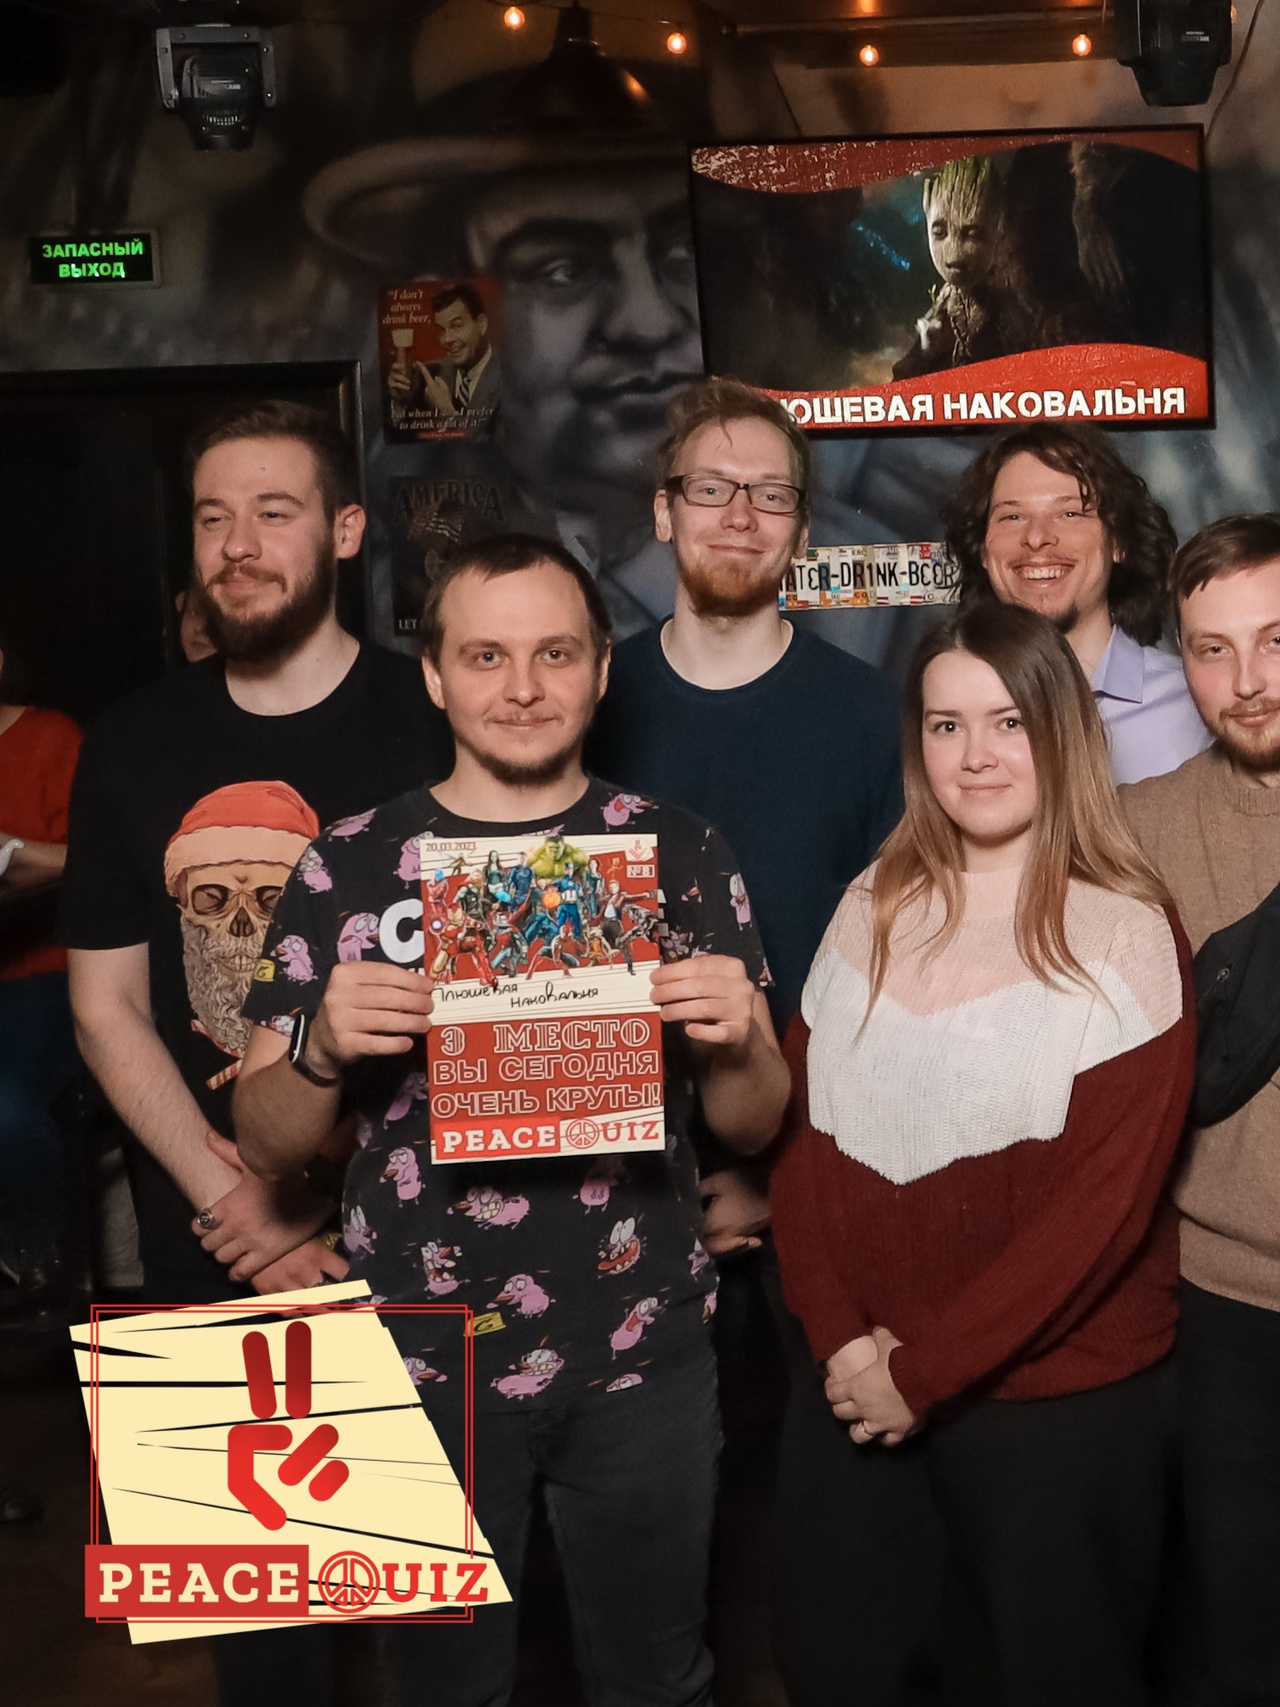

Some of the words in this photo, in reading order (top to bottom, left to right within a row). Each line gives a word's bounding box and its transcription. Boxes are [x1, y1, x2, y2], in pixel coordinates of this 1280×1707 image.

[42, 238, 144, 258] ЗАПАСНЫЙ
[58, 262, 125, 278] ВЫХОД
[400, 289, 423, 299] don't
[391, 302, 421, 312] always
[383, 314, 406, 324] drink
[408, 408, 432, 418] when
[466, 406, 495, 419] prefer
[779, 393, 934, 425] ЮШЕВАЯ
[942, 387, 1186, 420] НАКОВАЛЬНЯ
[399, 421, 409, 430] to
[410, 419, 435, 429] drink
[394, 480, 507, 523] AMERICA
[398, 618, 417, 630] LET
[440, 1026, 466, 1056] 3
[493, 1018, 650, 1053] МЕСТО
[433, 1058, 487, 1085] ВЫ
[498, 1050, 659, 1082] СЕГОДНЯ
[431, 1089, 540, 1118] ОЧЕНЬ
[546, 1083, 662, 1112] КРУТЫ!
[443, 1125, 556, 1152] PEACE
